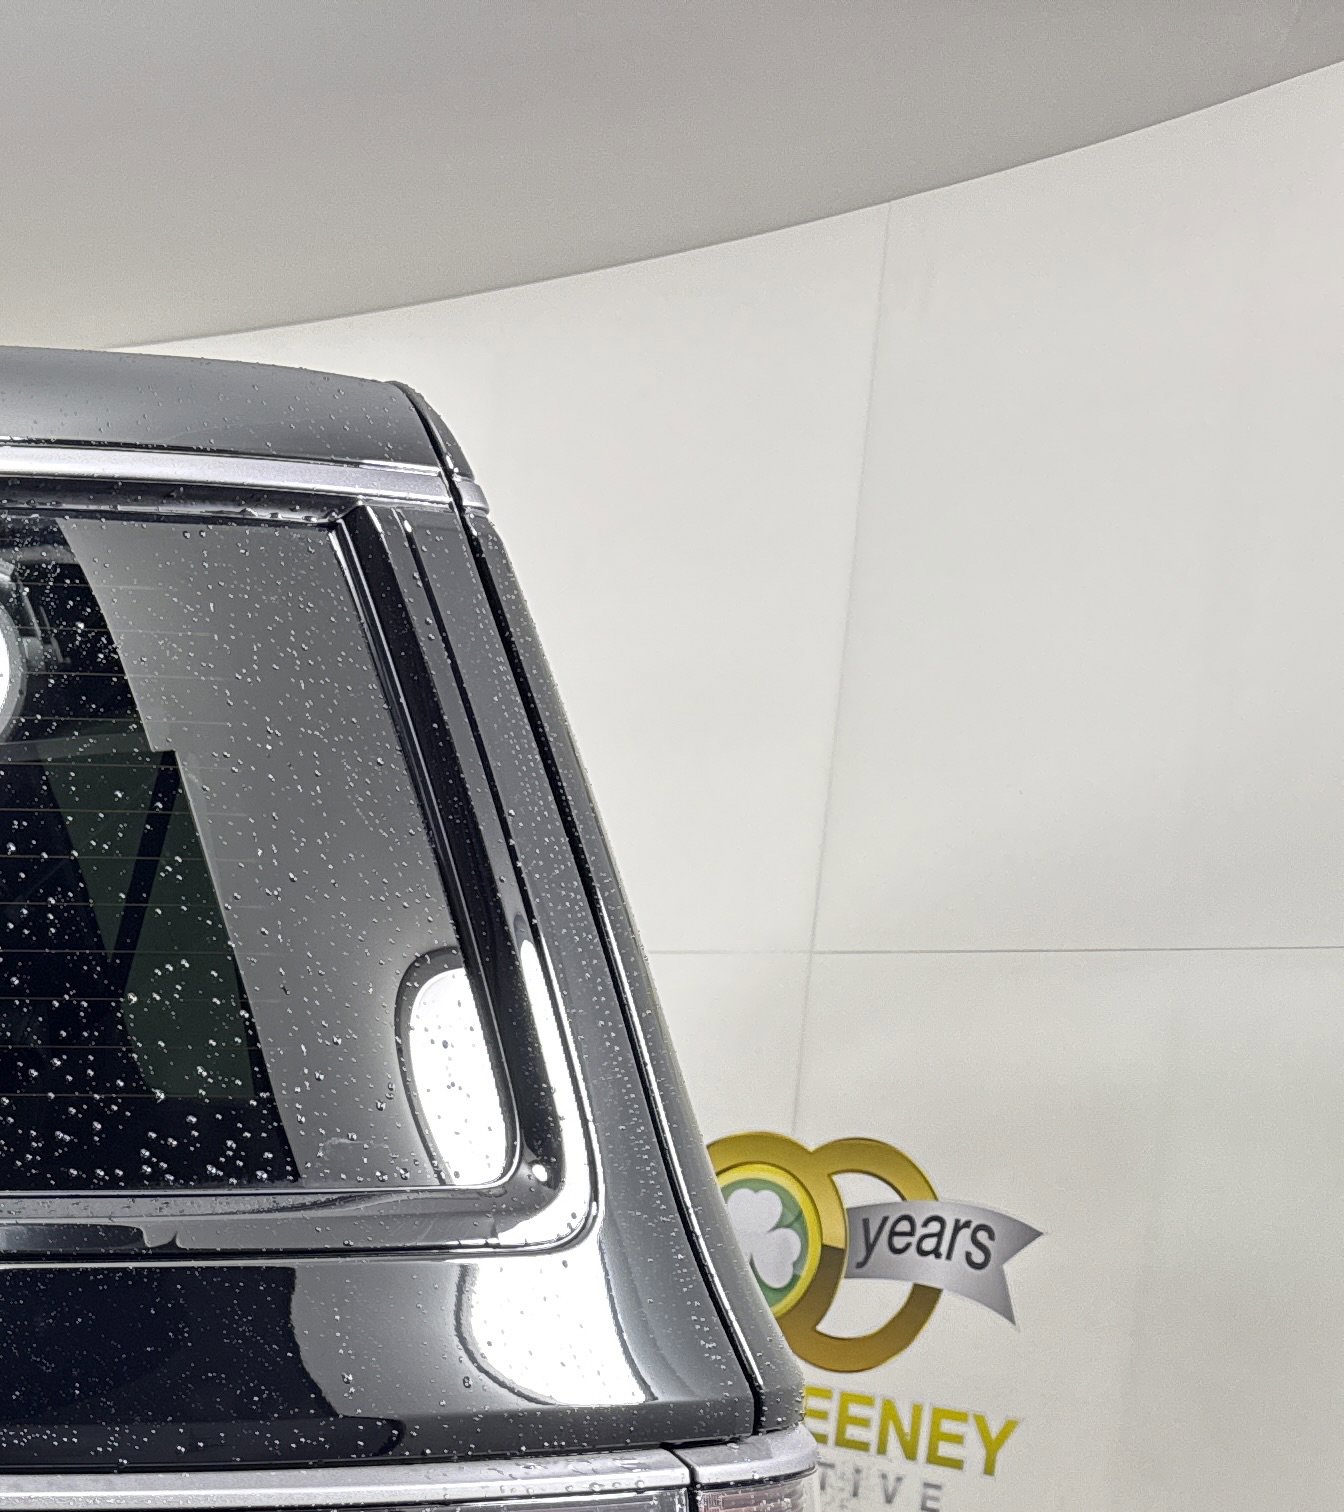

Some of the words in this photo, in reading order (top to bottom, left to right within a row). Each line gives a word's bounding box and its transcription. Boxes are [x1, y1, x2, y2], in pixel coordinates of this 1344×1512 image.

[706, 1131, 944, 1373] 00
[855, 1213, 996, 1271] years
[804, 1385, 1020, 1476] EENEY
